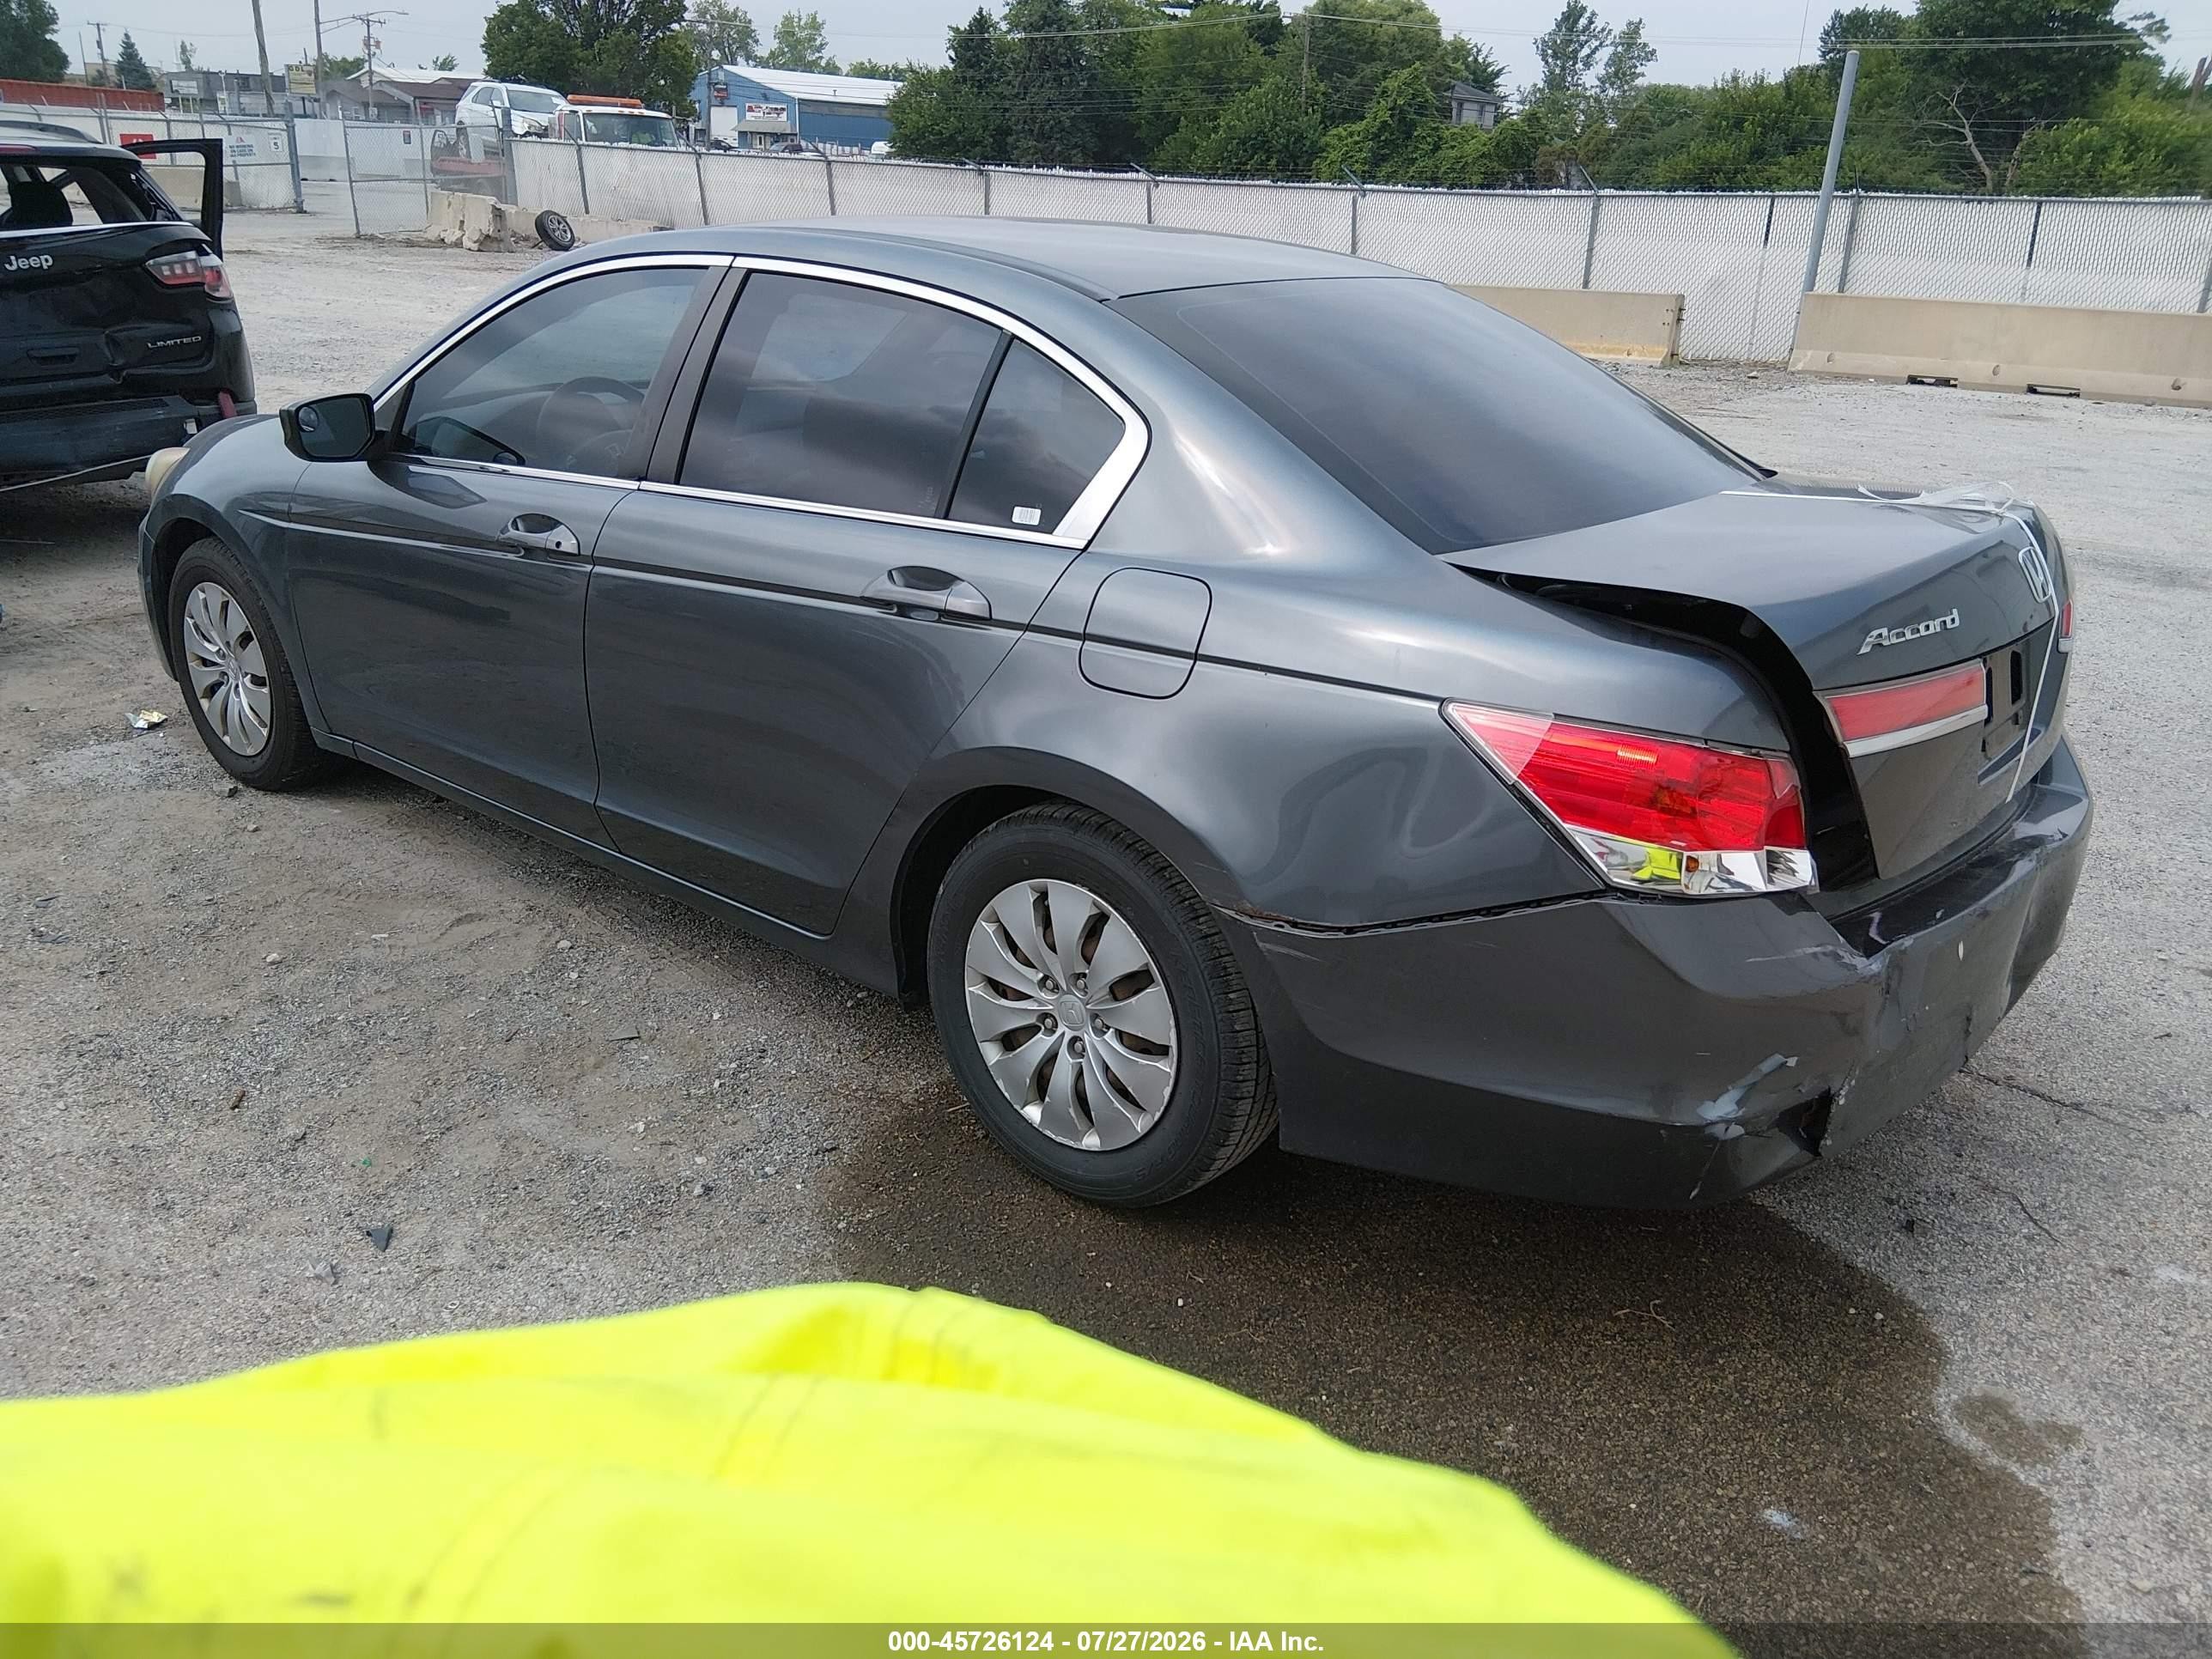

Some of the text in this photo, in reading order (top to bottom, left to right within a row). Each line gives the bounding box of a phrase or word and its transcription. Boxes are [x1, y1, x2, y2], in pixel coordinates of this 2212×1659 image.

[4, 254, 53, 271] Jeep
[147, 336, 202, 349] LIMITED
[1855, 608, 1960, 655] Accord
